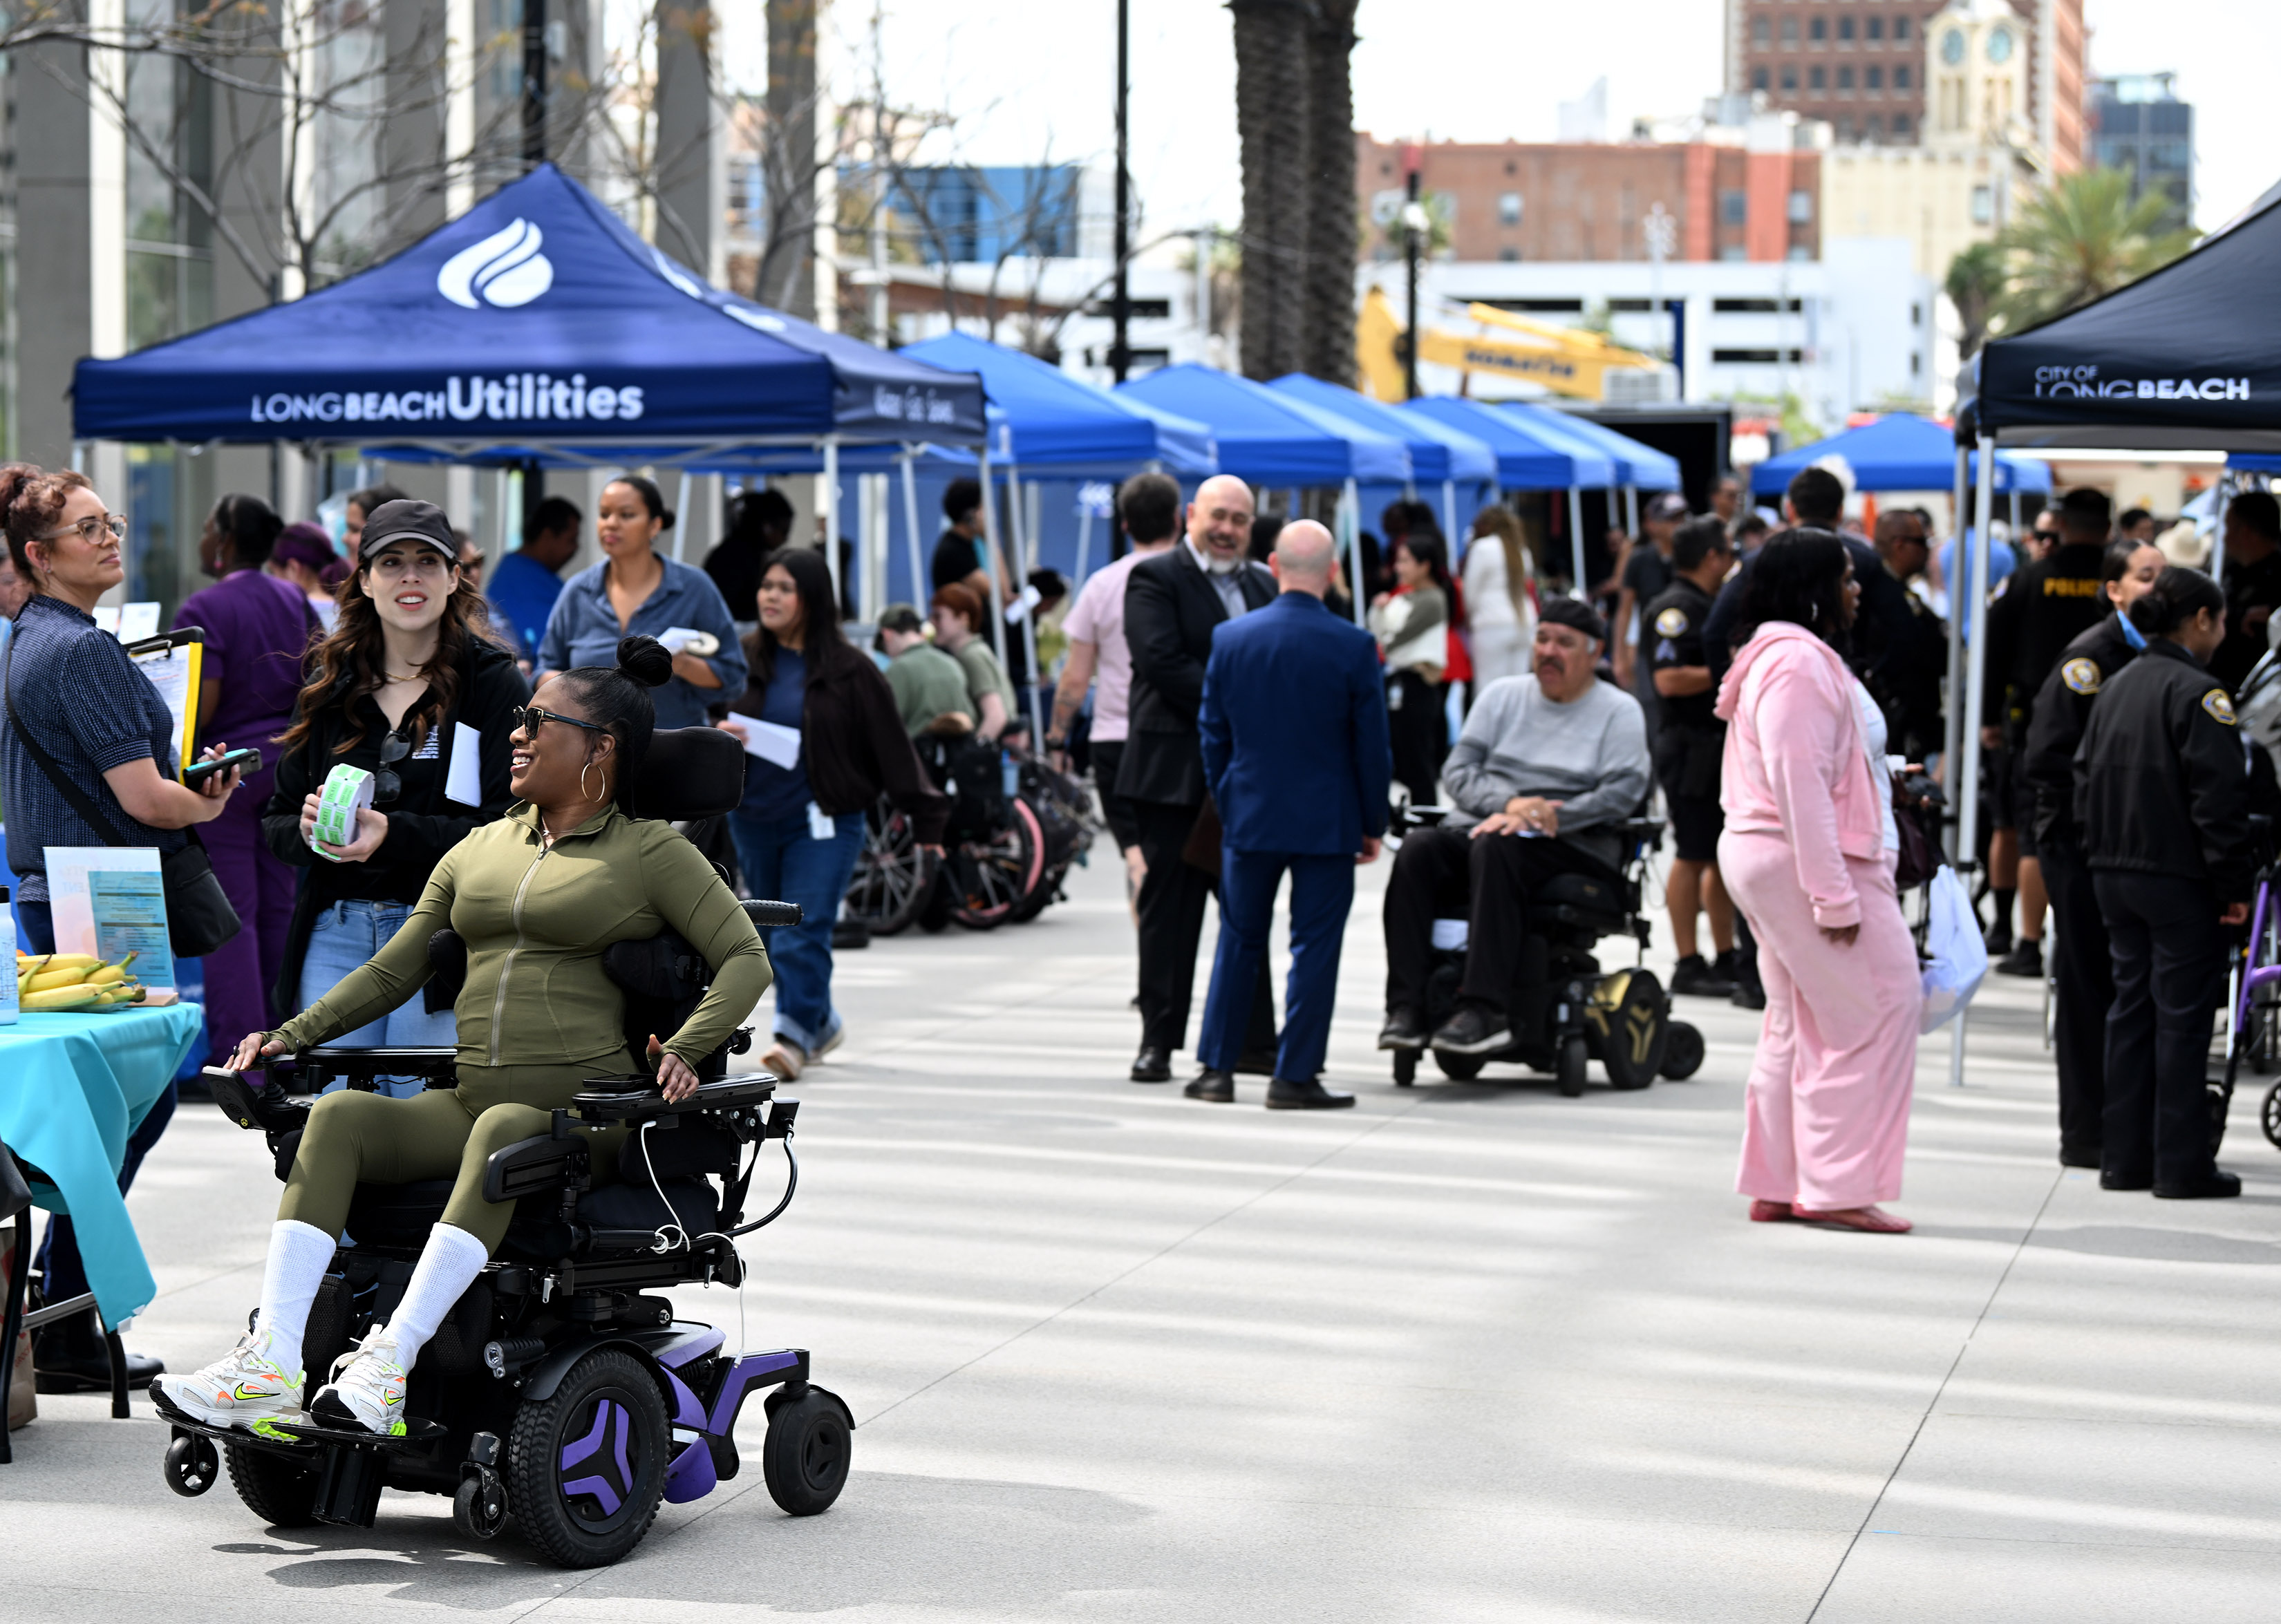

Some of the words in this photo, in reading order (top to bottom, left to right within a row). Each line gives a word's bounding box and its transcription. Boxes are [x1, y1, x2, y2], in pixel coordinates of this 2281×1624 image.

[2035, 366, 2071, 381] CITY
[2074, 365, 2098, 381] OF
[2043, 578, 2103, 598] POLIC
